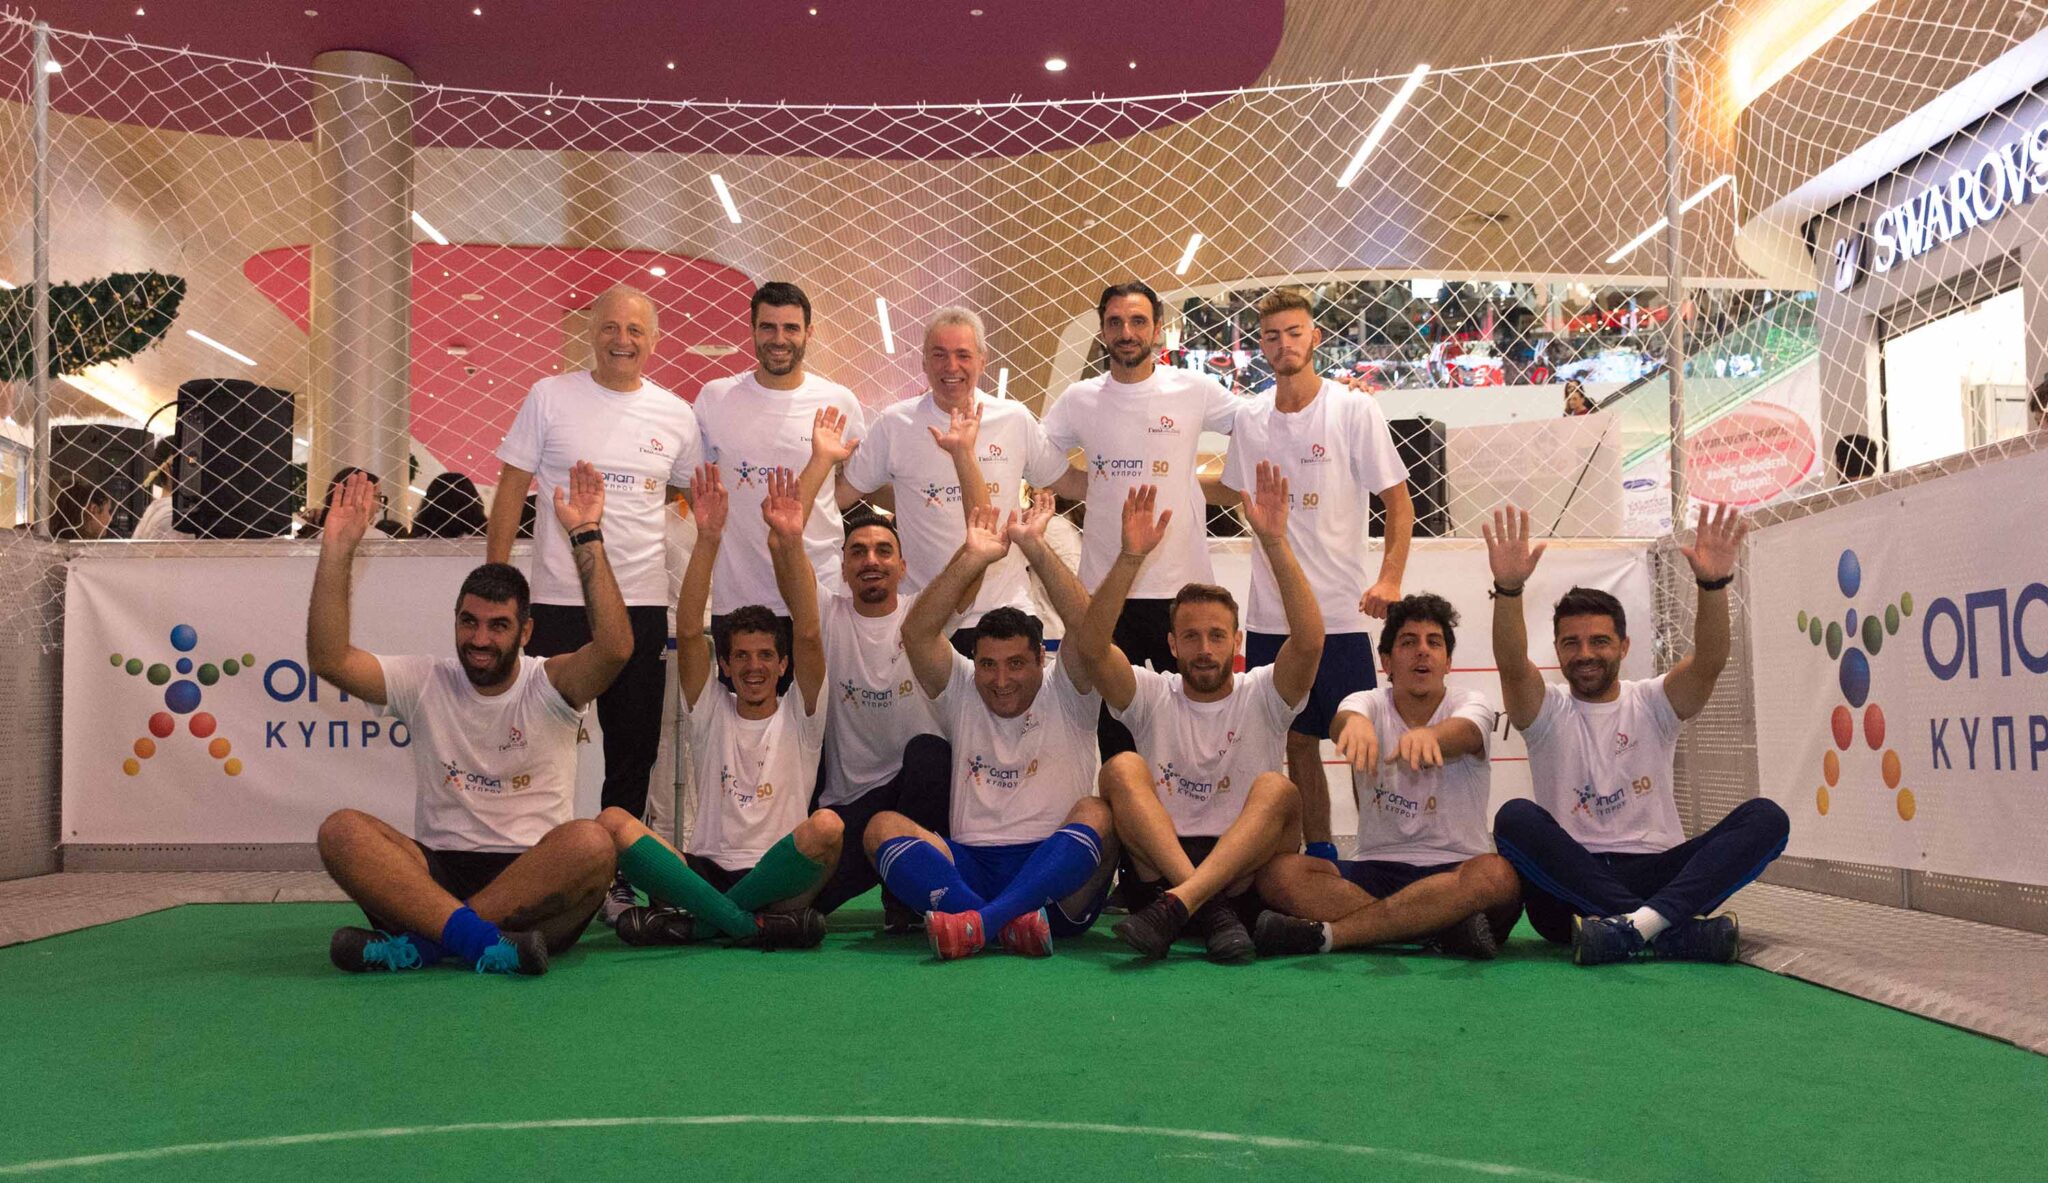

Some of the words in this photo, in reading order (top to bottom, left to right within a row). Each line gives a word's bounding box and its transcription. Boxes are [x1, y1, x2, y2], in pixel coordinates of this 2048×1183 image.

[1873, 121, 2048, 272] SWAROVS
[1152, 460, 1169, 473] 50
[1303, 493, 1319, 506] 50
[265, 720, 412, 748] ΚΥΠΡΟ
[1930, 715, 2048, 771] ΚΥΠΡ
[512, 774, 531, 789] 50
[1632, 776, 1651, 794] 50
[756, 783, 773, 798] 50
